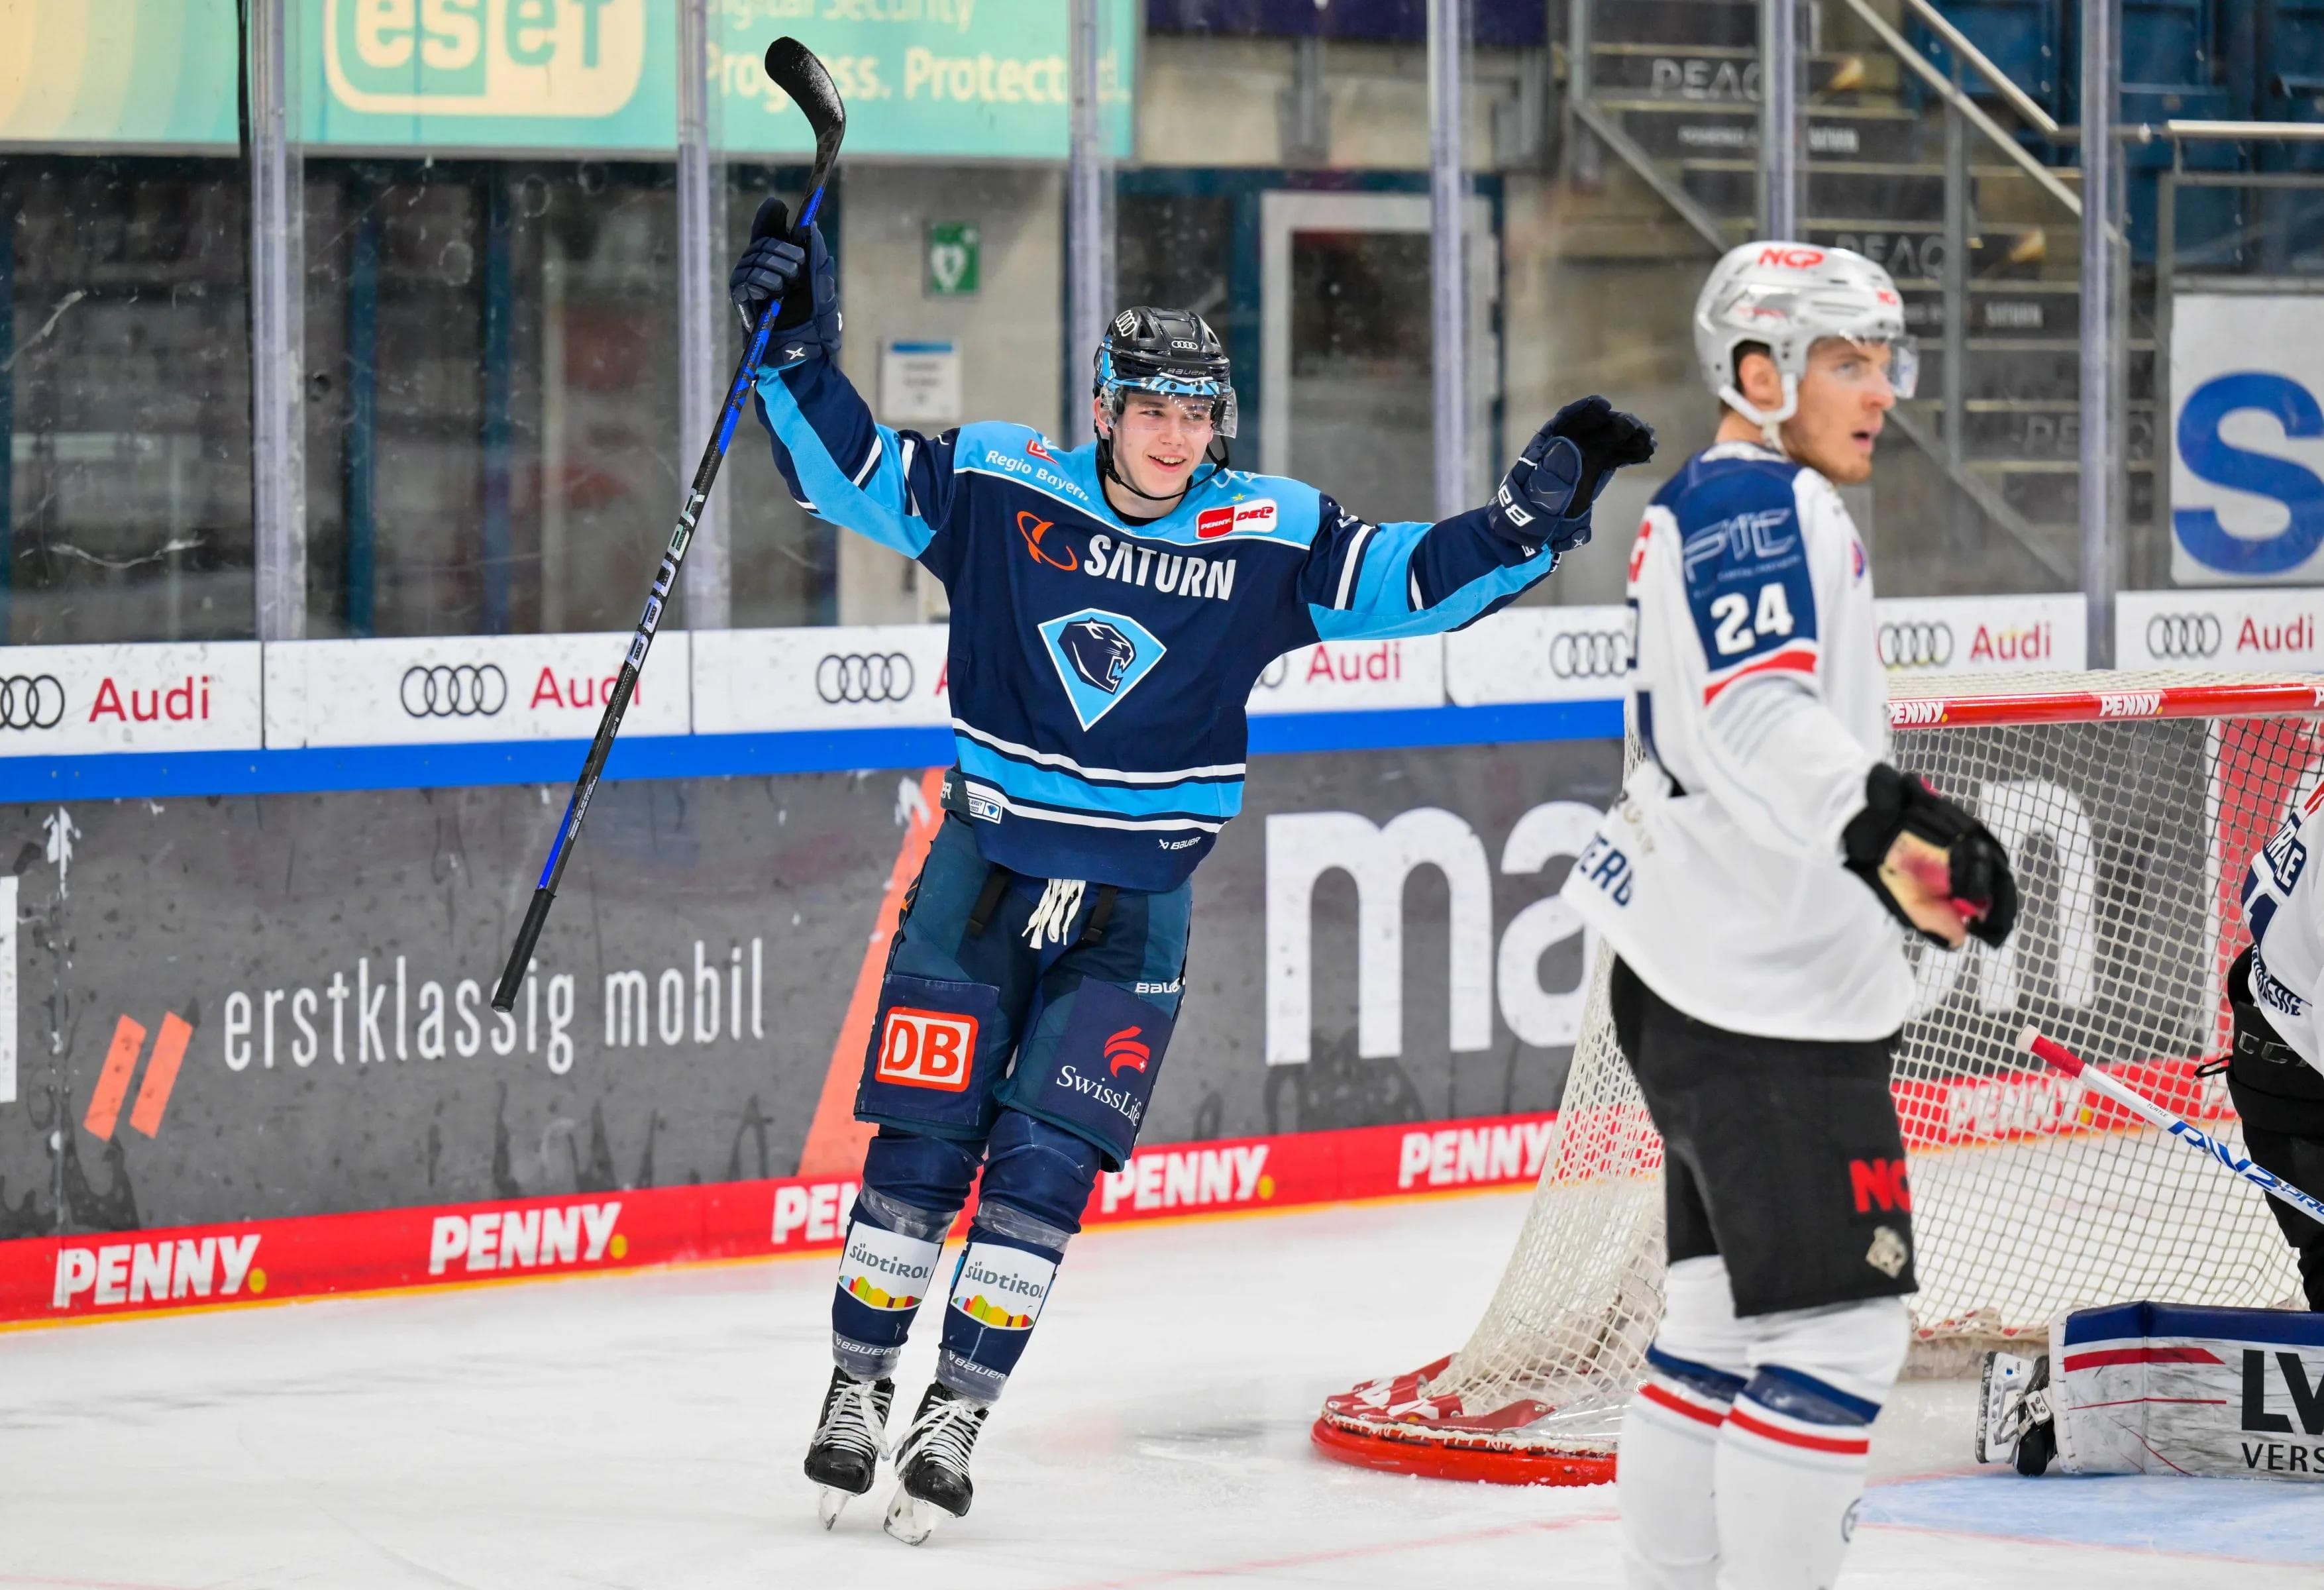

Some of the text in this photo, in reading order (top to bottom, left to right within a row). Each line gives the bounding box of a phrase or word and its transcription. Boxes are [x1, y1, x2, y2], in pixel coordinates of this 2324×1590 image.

[985, 450, 1031, 474] Regio
[1084, 534, 1236, 600] SATURN
[1710, 582, 1794, 655] 24
[2237, 614, 2315, 653] Audi
[1306, 641, 1401, 683] Audi
[1970, 622, 2052, 662] Audi
[88, 674, 209, 723] Audi
[1170, 836, 1202, 850] BAUER
[225, 937, 765, 1075] erstklassig mobil
[884, 1019, 961, 1077] DB
[840, 1340, 894, 1356] BAUER
[955, 1358, 1007, 1381] BAUER
